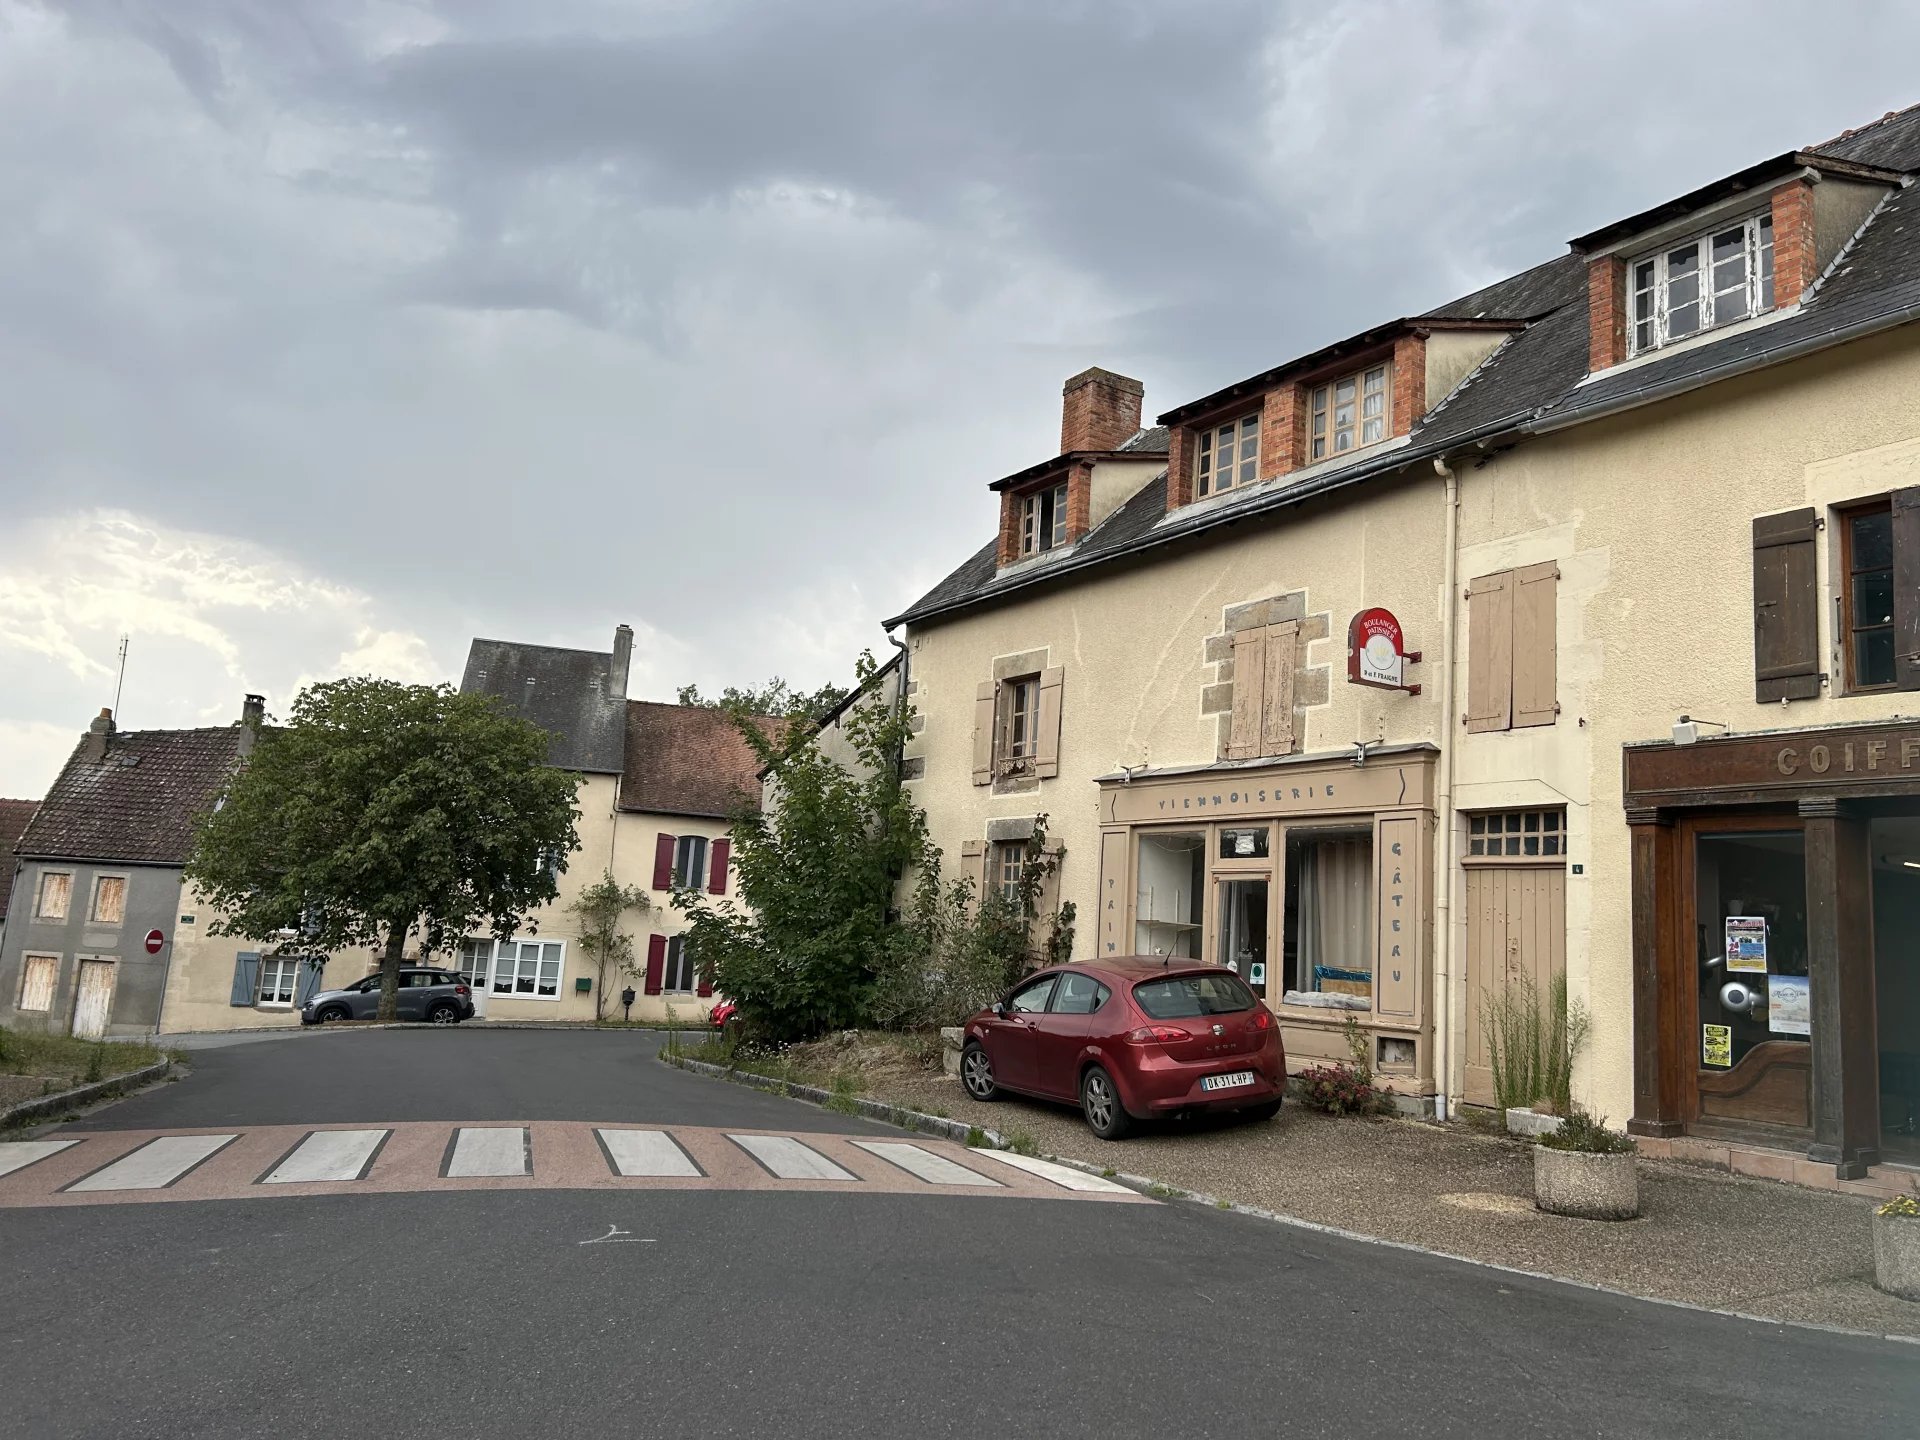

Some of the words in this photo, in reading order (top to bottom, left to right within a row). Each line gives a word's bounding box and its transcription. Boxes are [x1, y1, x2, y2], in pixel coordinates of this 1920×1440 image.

[1363, 619, 1398, 634] BOULANGER
[1367, 627, 1394, 640] PATISSIER
[1777, 738, 1920, 775] COIFF
[1159, 784, 1334, 810] VIENNOISERIE
